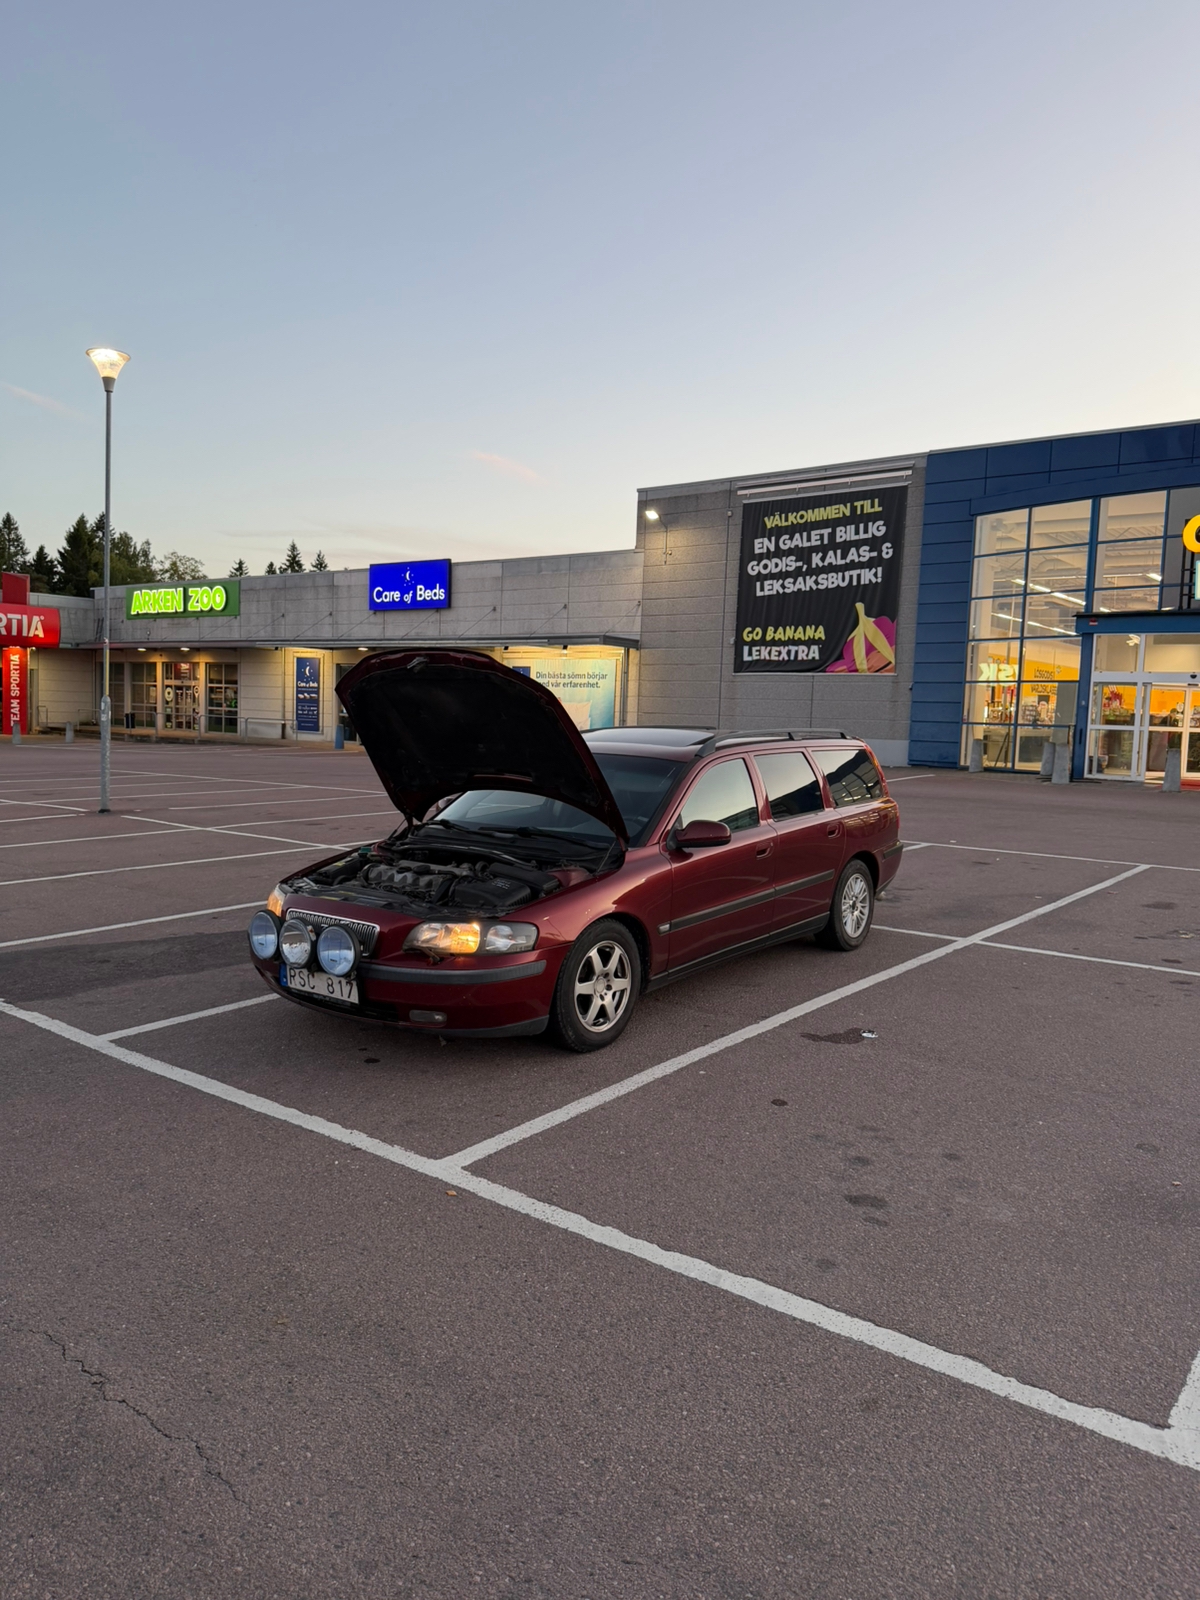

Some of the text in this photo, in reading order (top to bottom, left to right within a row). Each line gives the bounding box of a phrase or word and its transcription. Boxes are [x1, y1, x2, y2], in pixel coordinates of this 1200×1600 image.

[764, 498, 883, 529] VÄLKOMMEN TILL
[754, 520, 887, 554] EN GALET BILLIG
[747, 542, 894, 576] GODIS-, KALAS- &
[373, 583, 445, 604] Care of Beds
[756, 566, 883, 597] LEKSAKSBUTIK!
[130, 585, 226, 615] ARKEN ZOO
[742, 624, 826, 642] GO BANANA
[742, 645, 820, 661] LEKEXTRA
[10, 654, 20, 697] SPORTIA
[536, 671, 608, 681] Din bästa sömn börjar
[551, 679, 561, 687] vår
[562, 680, 601, 689] erfarenhet.
[289, 968, 316, 990] RSC
[326, 977, 354, 999] 817
